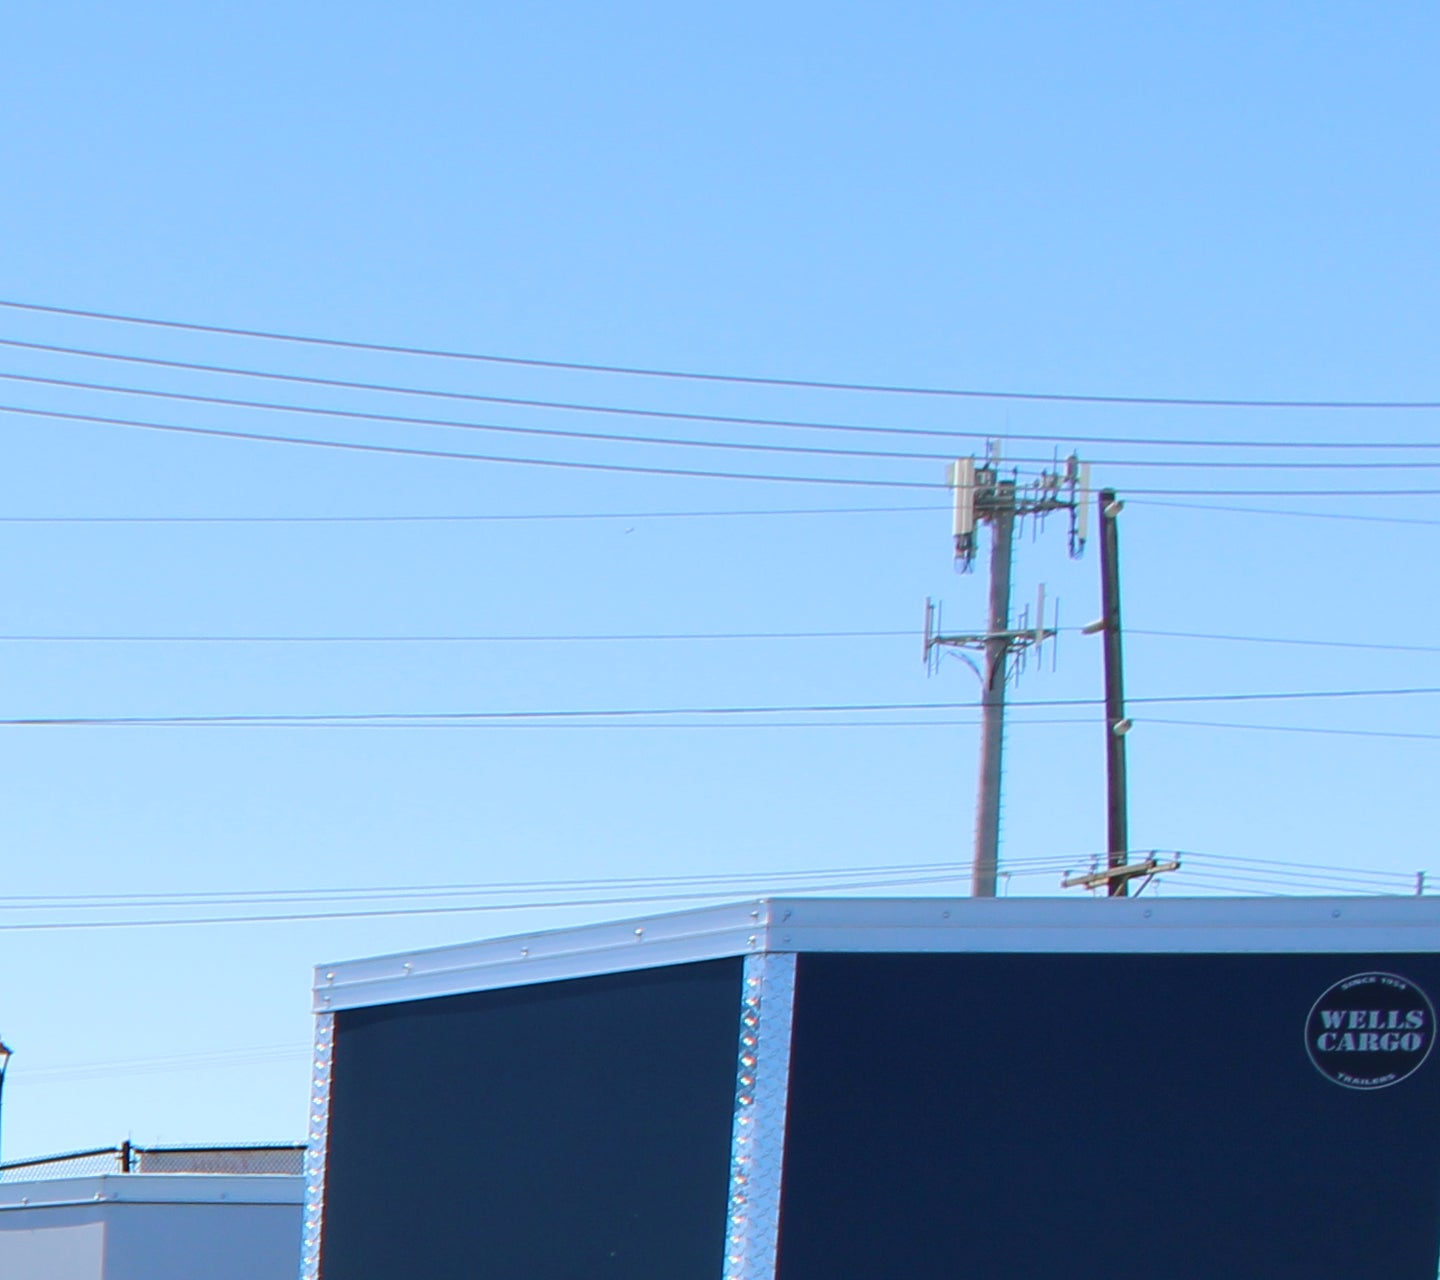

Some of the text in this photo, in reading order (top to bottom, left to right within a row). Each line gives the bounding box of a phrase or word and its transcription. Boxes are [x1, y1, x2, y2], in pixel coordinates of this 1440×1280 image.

[1341, 976, 1377, 991] SINCE
[1320, 1010, 1424, 1029] WELLS
[1317, 1032, 1422, 1051] CARGO
[1337, 1072, 1396, 1085] TRAILERS
